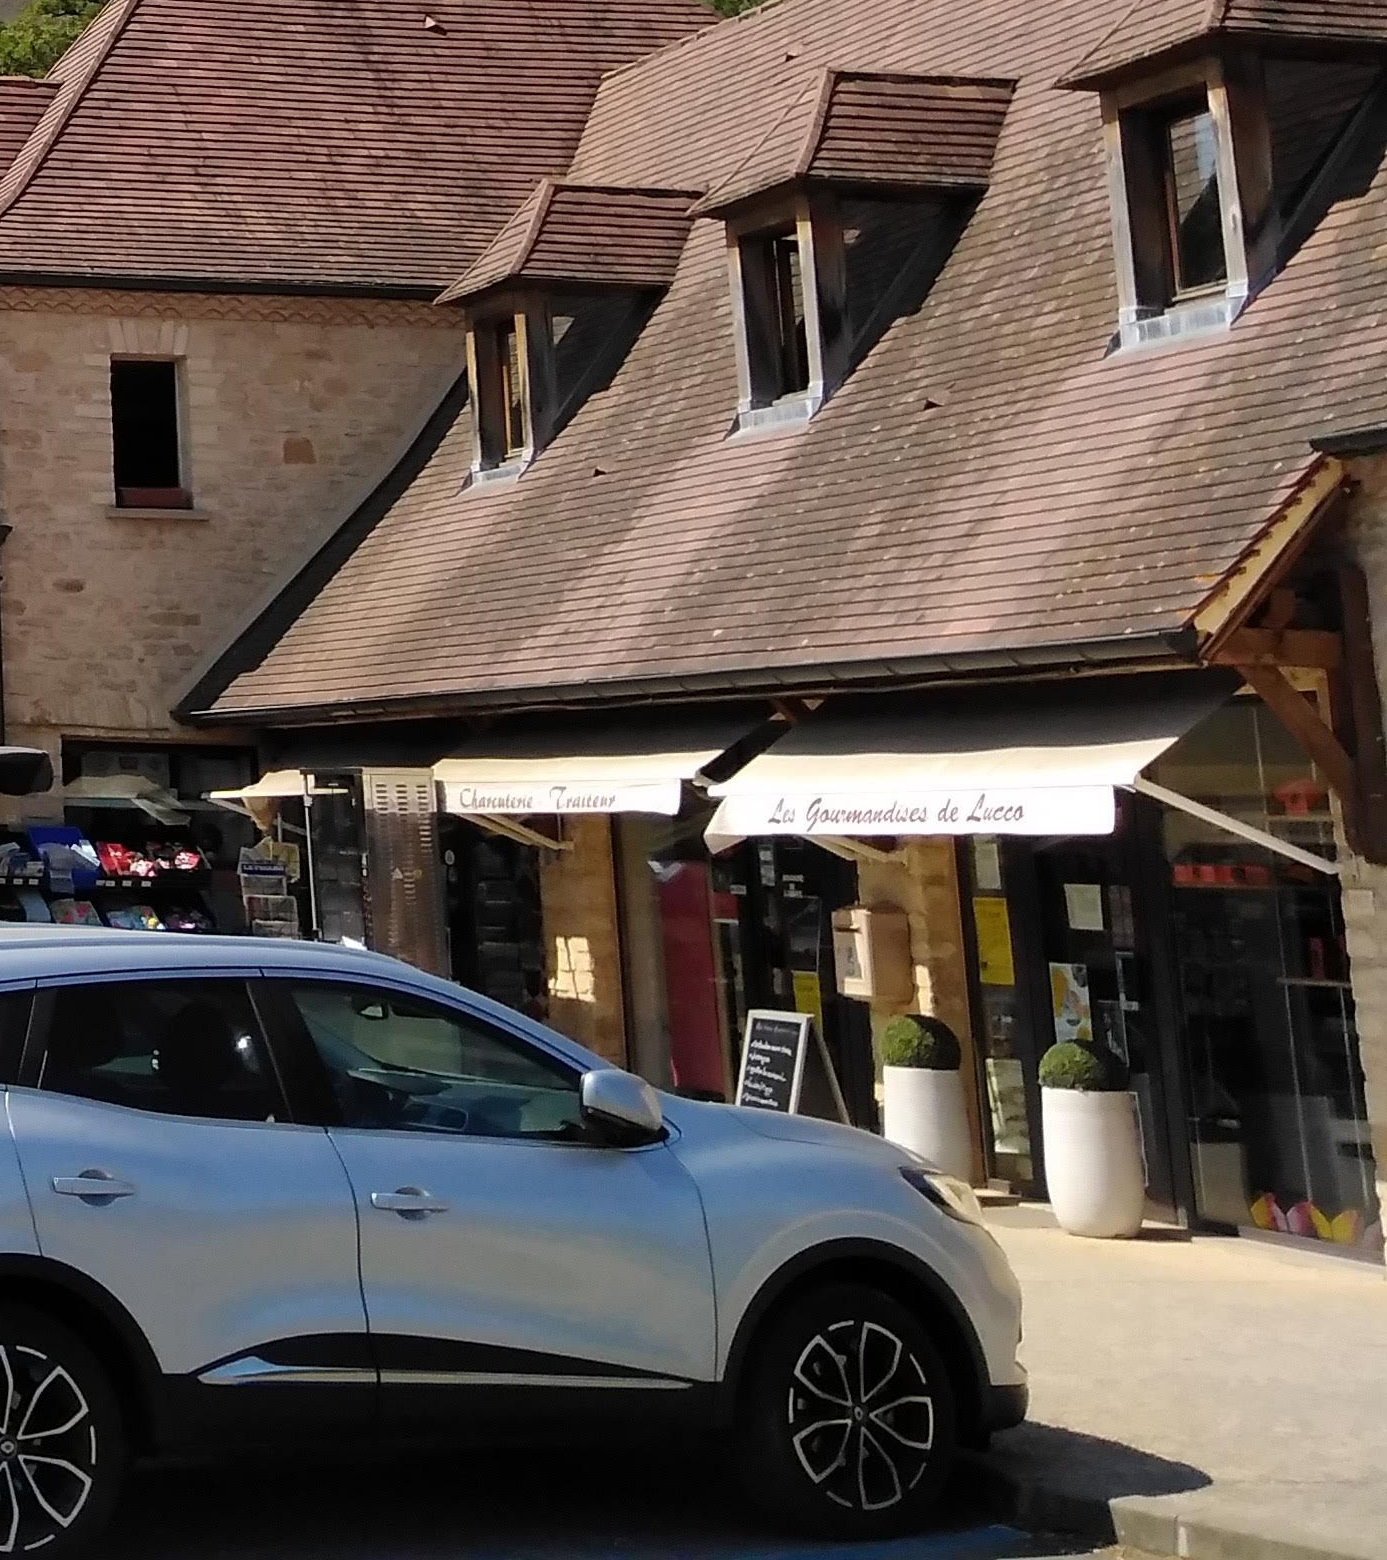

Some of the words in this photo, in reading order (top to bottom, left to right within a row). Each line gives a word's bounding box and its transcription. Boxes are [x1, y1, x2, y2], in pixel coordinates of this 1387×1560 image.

[459, 787, 533, 810] Charcuterie
[549, 785, 616, 810] Traiteur
[768, 797, 796, 825] Les
[805, 797, 928, 833] Gourmandises
[937, 797, 960, 823] de
[965, 792, 1025, 823] Lucco
